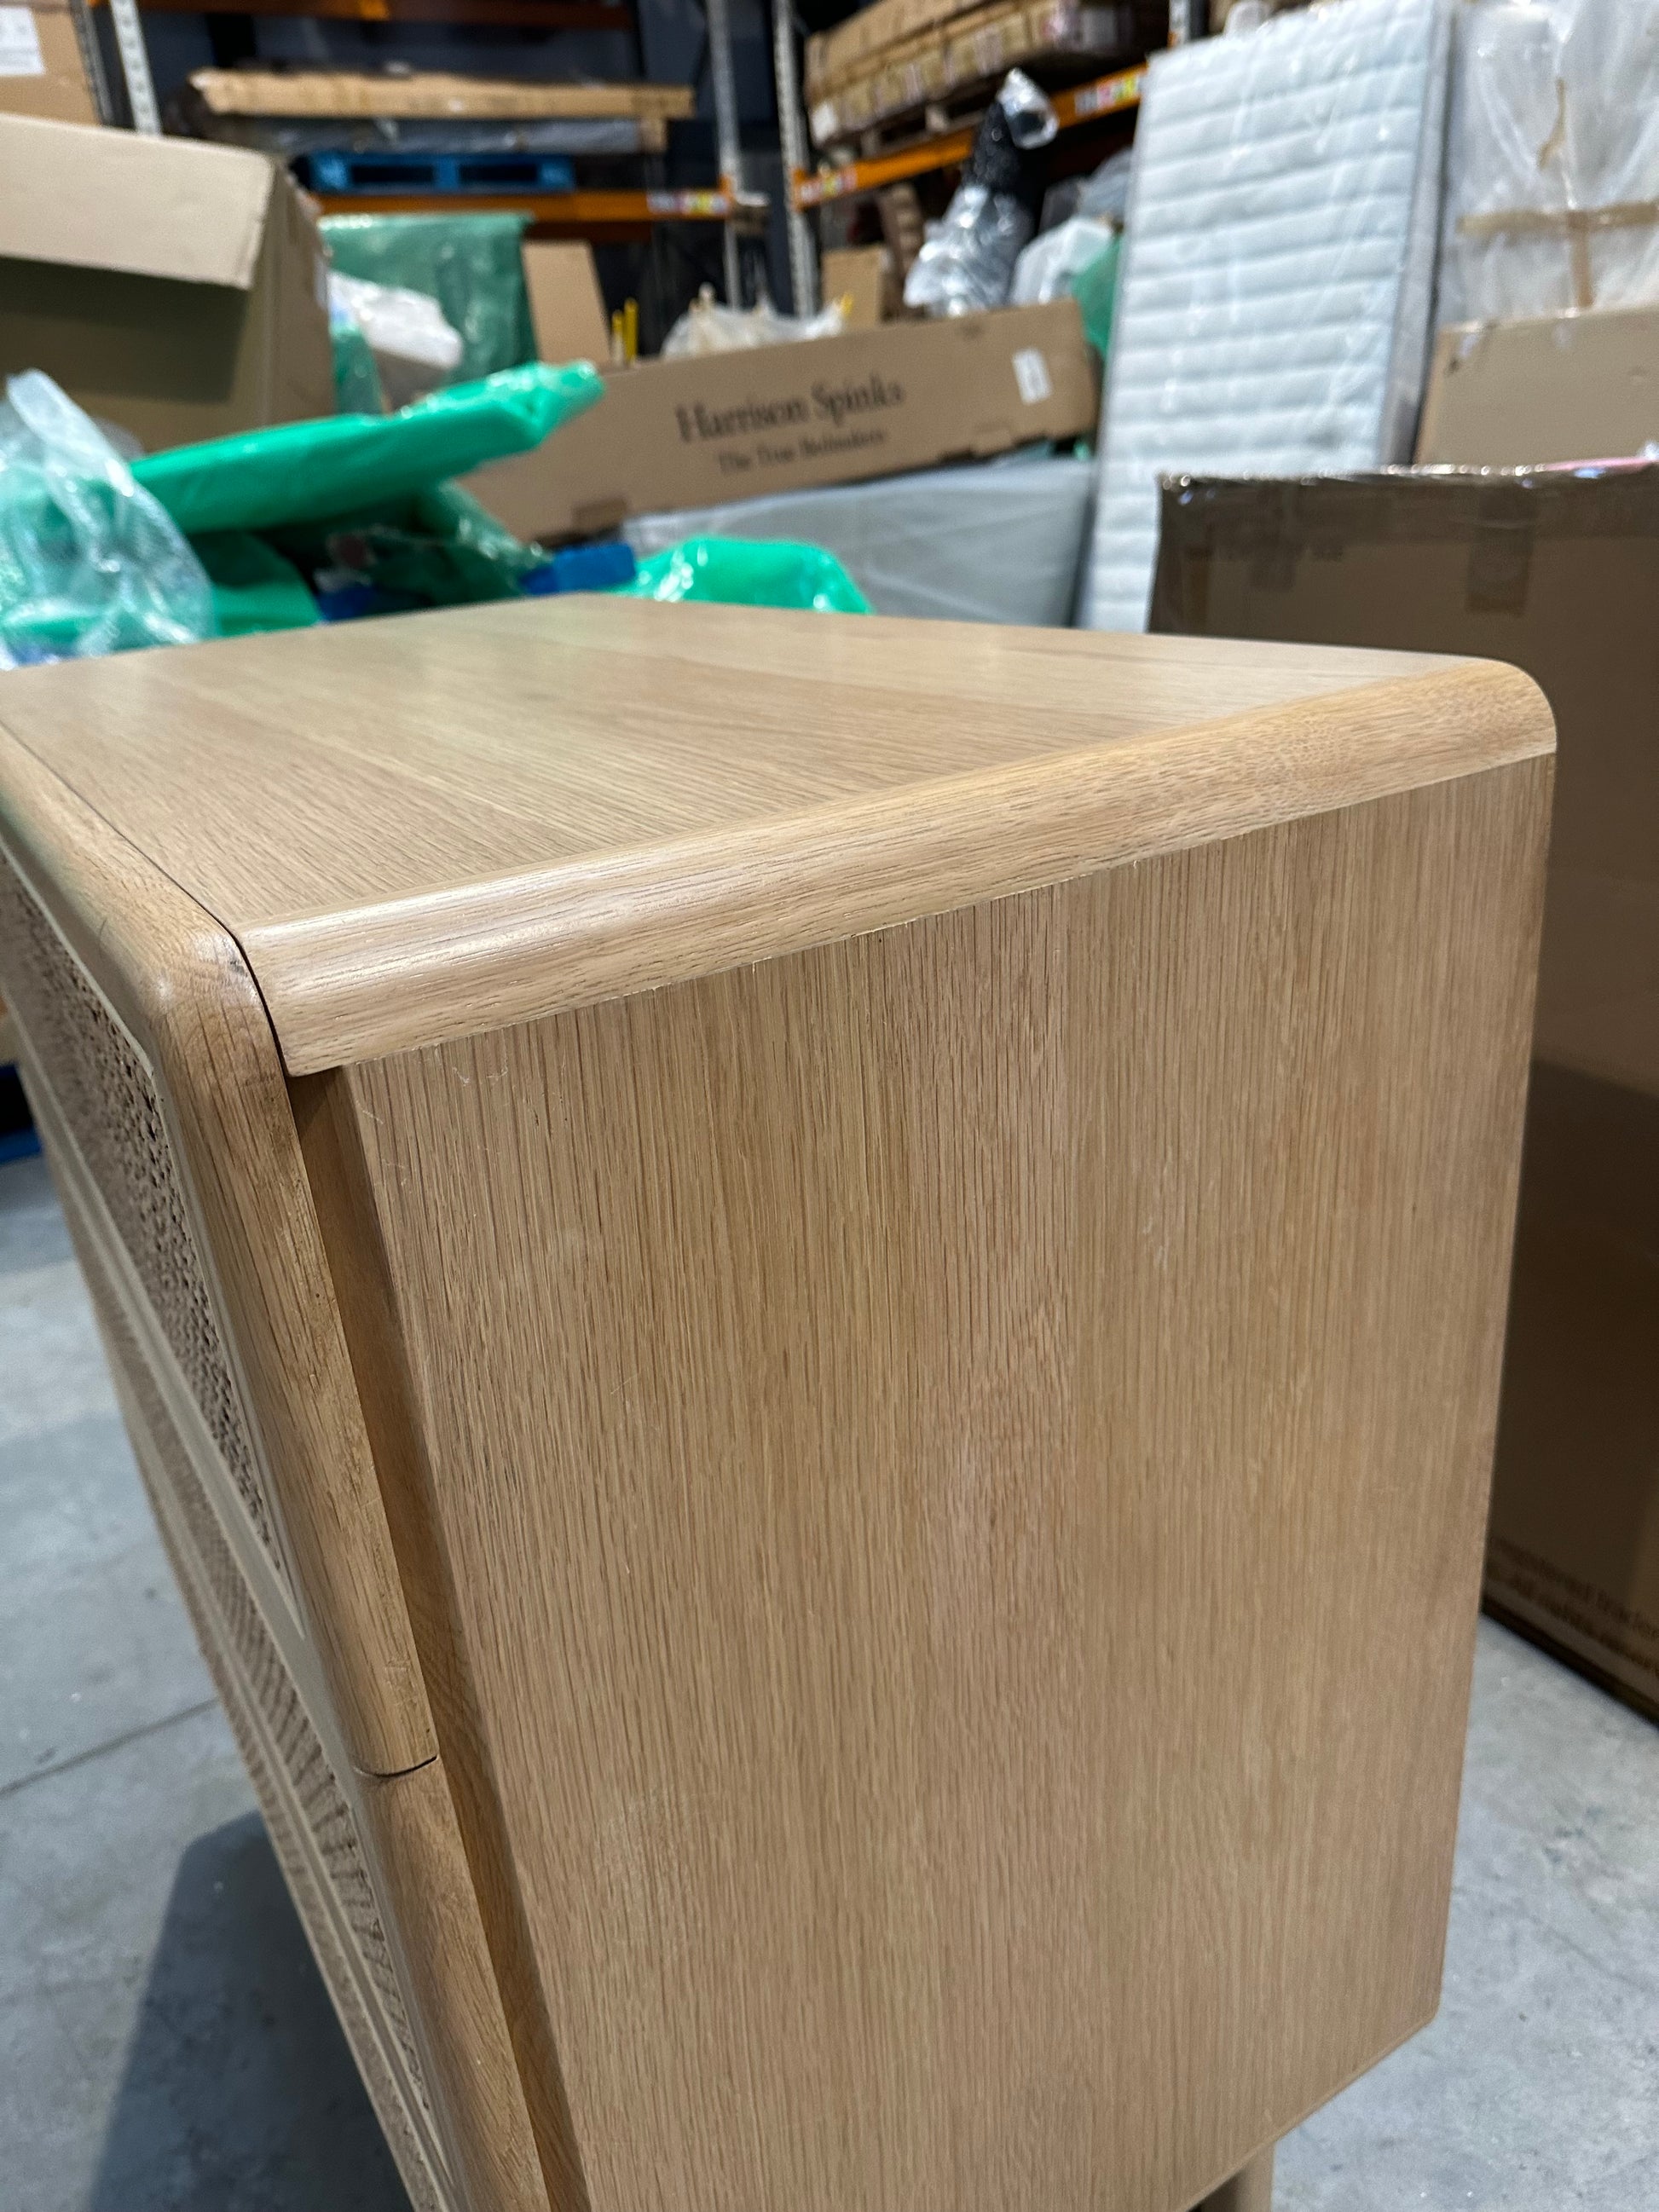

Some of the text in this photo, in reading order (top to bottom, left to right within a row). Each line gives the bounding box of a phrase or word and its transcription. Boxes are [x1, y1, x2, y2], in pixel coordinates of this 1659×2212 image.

[676, 373, 904, 443] Harrison Spinks
[718, 450, 752, 474] The
